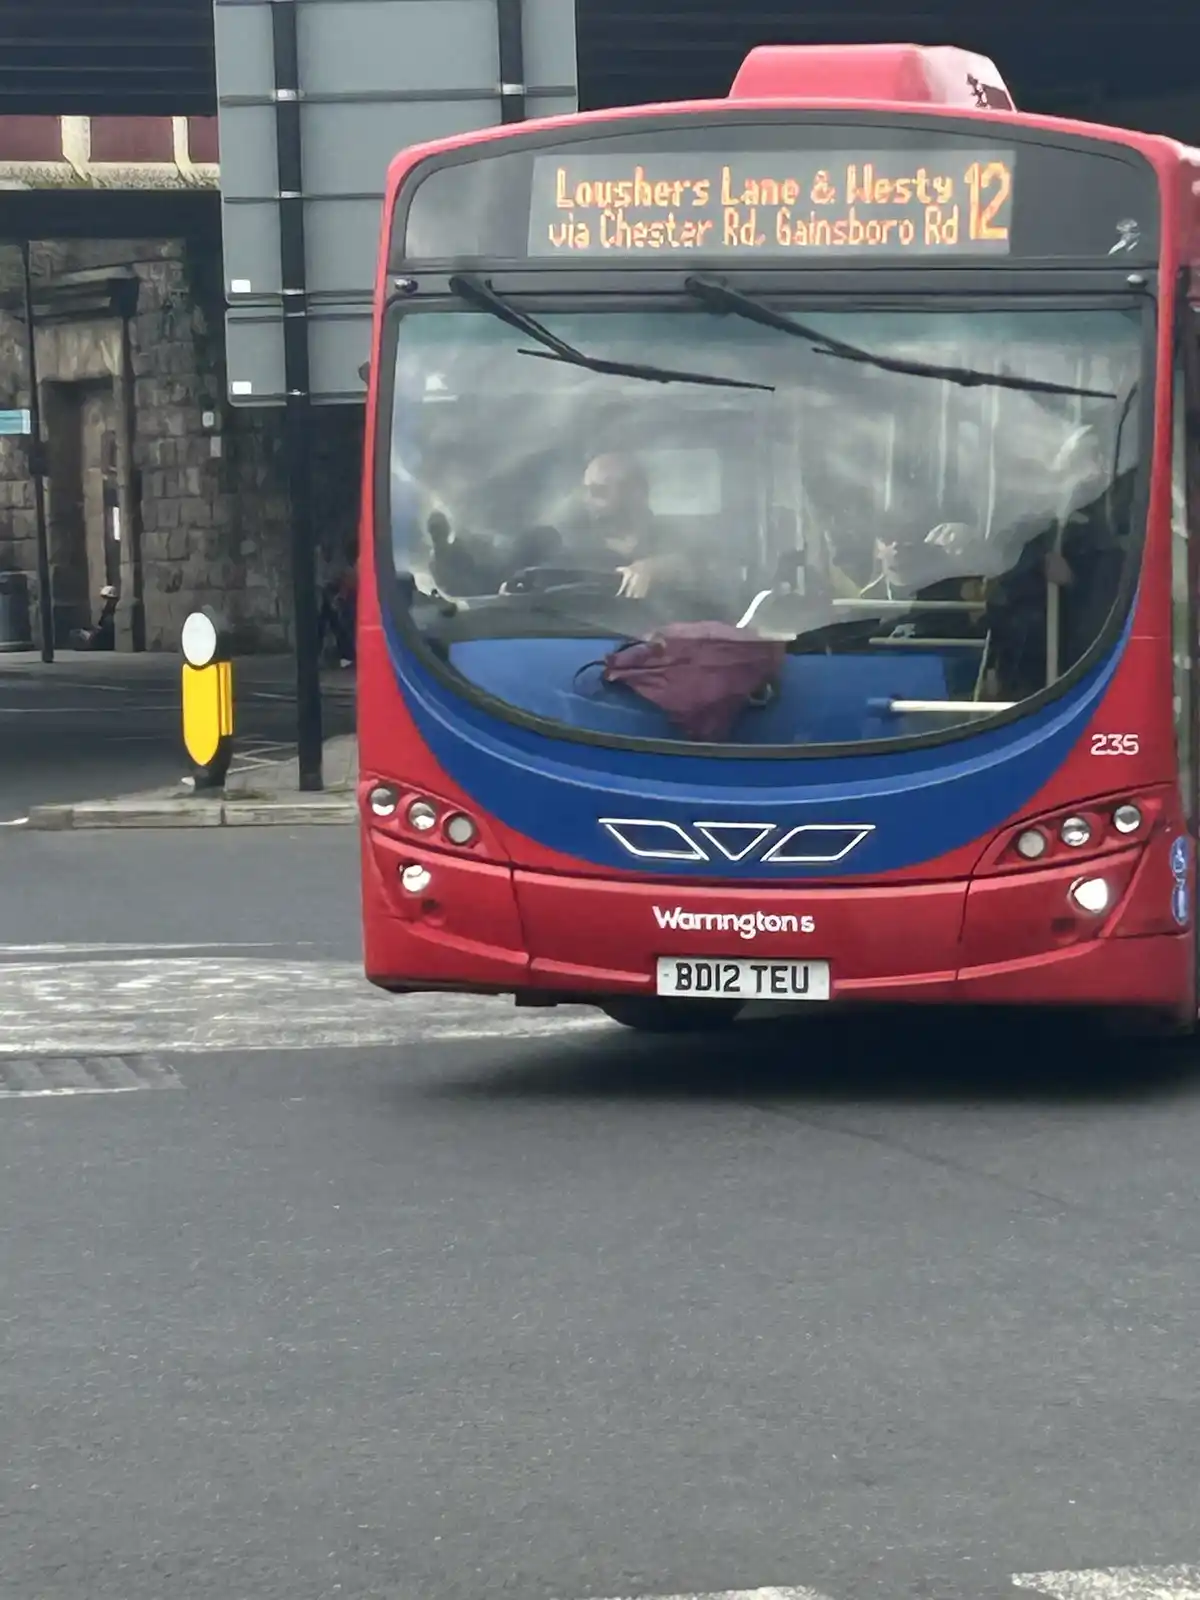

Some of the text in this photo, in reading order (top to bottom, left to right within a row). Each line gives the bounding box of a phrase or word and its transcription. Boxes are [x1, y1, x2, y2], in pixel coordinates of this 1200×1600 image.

[721, 166, 799, 206] Lane
[810, 170, 836, 204] &
[964, 160, 1010, 240] 12
[549, 213, 590, 249] via
[776, 206, 914, 246] Gainsboro
[924, 203, 959, 245] Rd
[1090, 733, 1139, 756] 235
[675, 962, 809, 994] BD12 TEU
